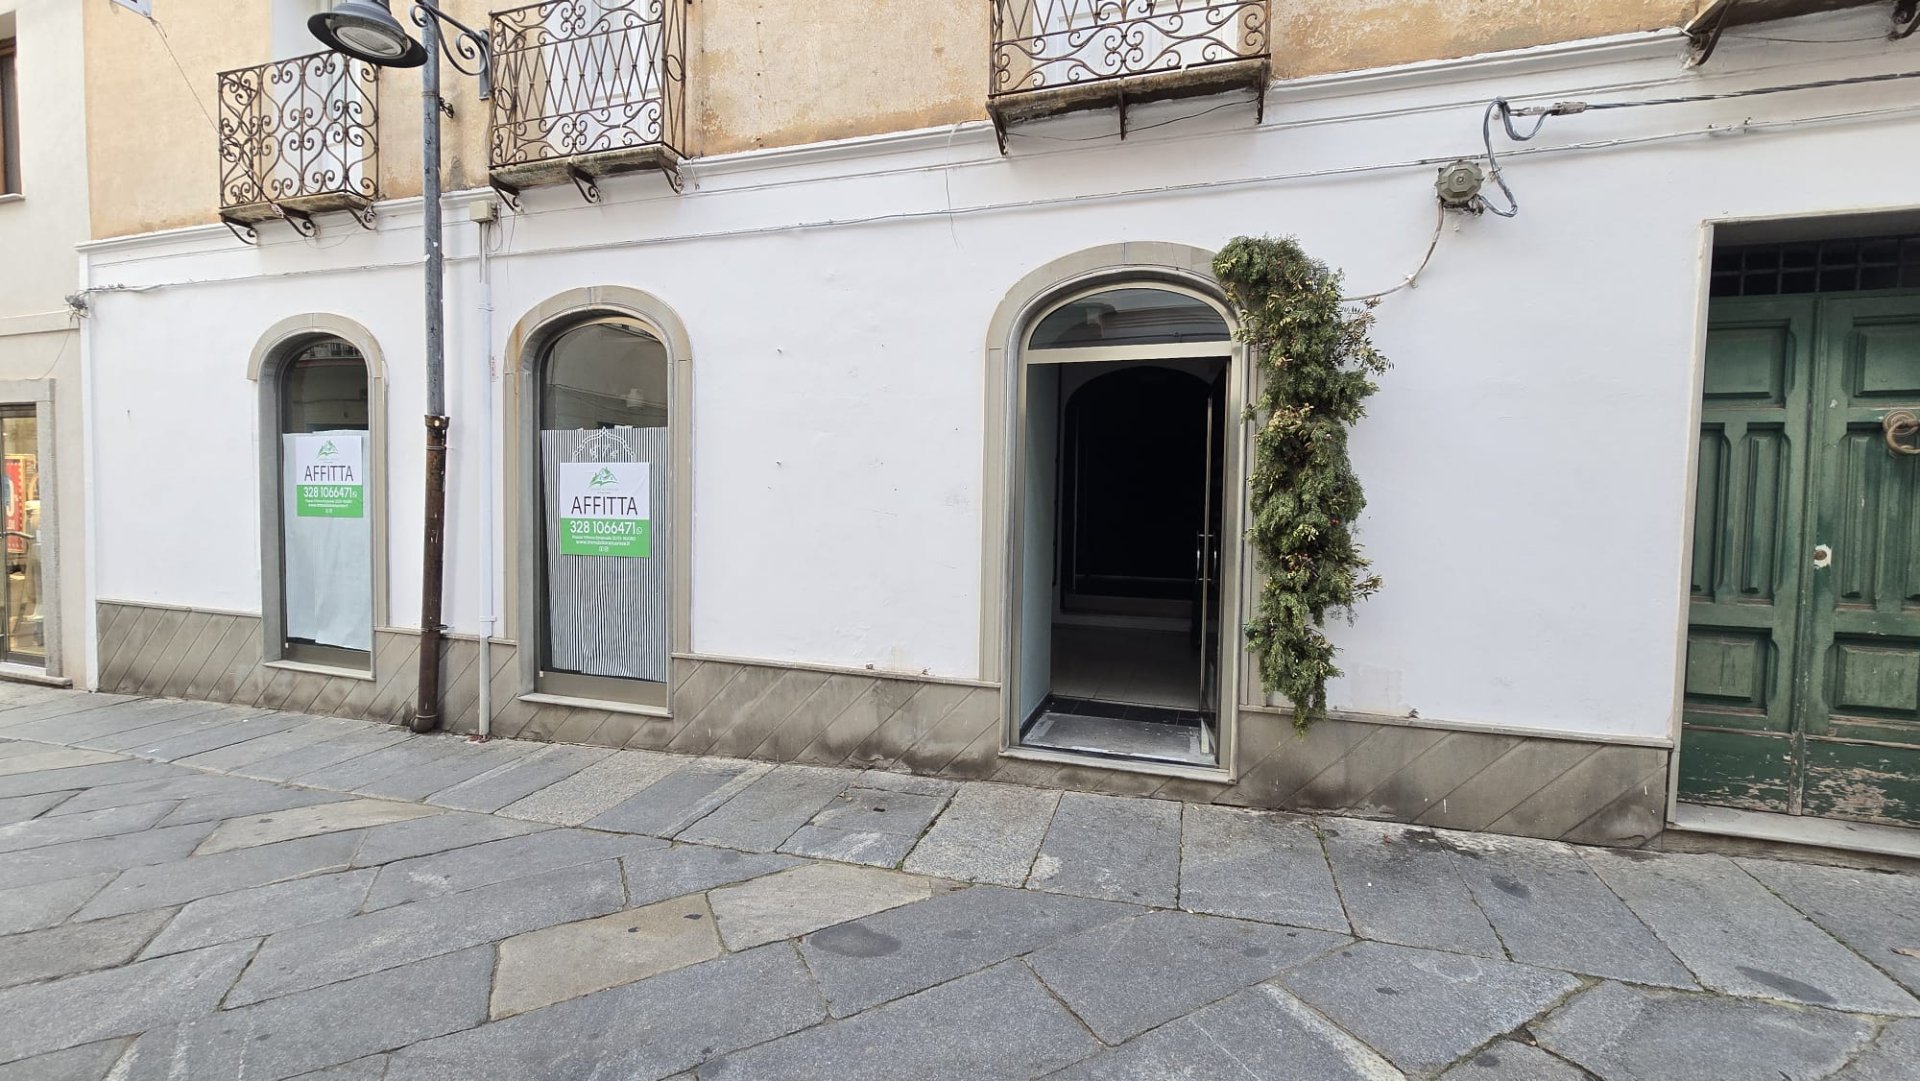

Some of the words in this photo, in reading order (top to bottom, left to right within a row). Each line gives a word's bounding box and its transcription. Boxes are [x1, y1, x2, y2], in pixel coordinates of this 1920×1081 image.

[304, 465, 354, 482] AFFITTA
[303, 487, 319, 498] 328
[320, 487, 352, 498] 1066471
[571, 496, 638, 515] AFFITTA
[570, 520, 590, 533] 328
[593, 521, 636, 535] 1066471
